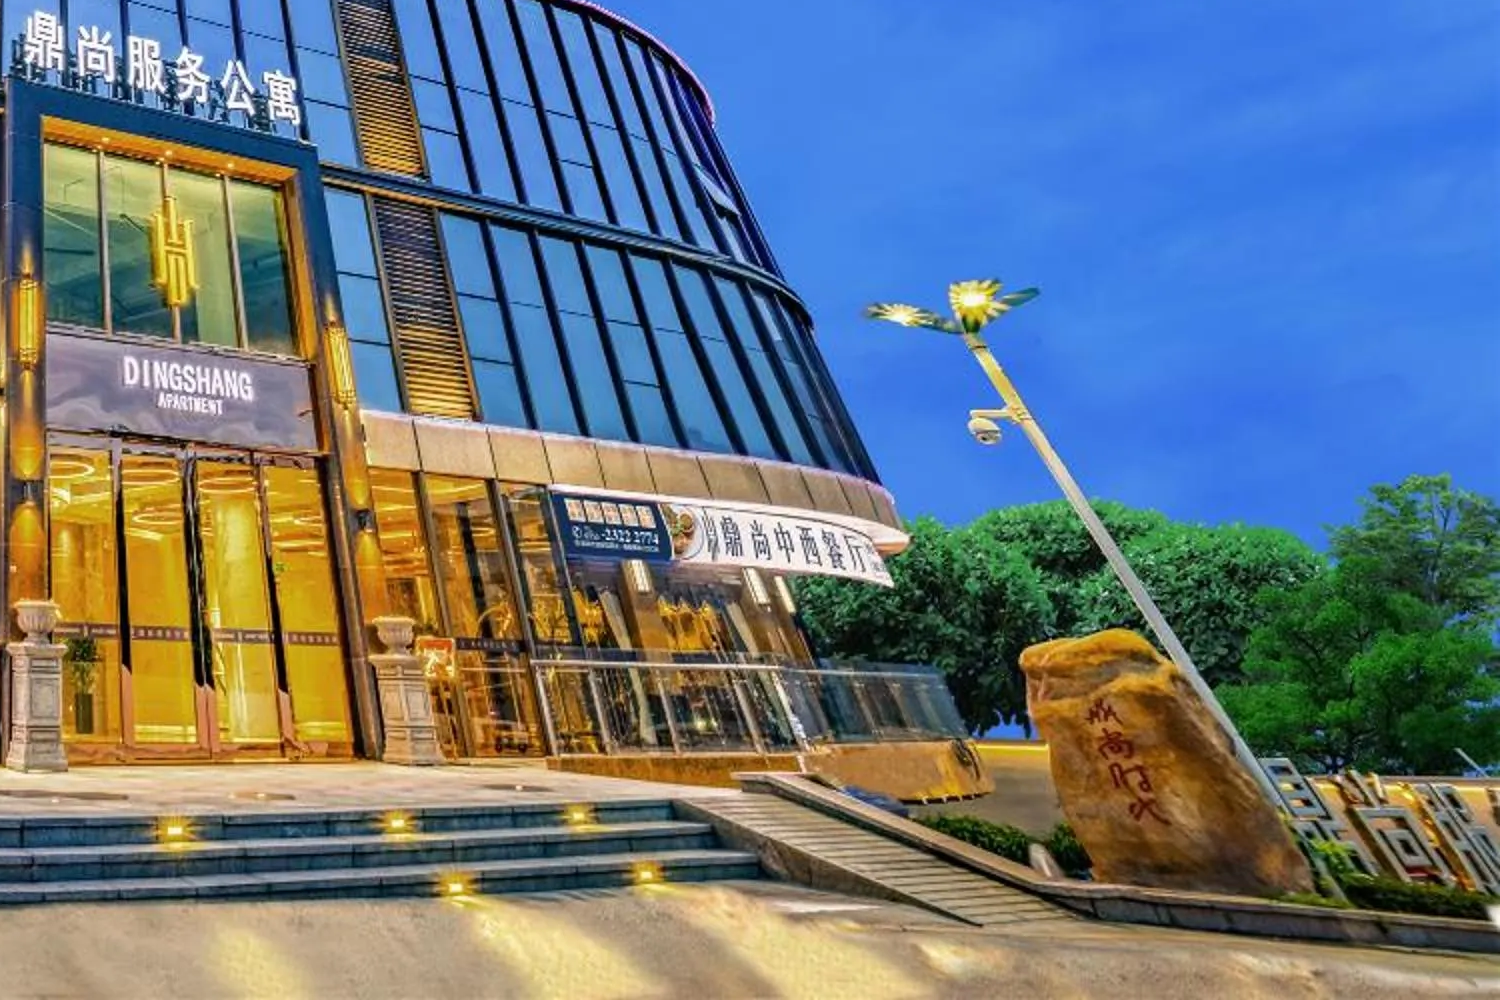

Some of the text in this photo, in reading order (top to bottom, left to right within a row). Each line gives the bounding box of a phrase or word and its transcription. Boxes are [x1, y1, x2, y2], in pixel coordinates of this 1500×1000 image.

[23, 9, 301, 126] 鼎尚服务公寓
[123, 355, 254, 402] DINGSHANG
[157, 391, 224, 416] APARTMENT
